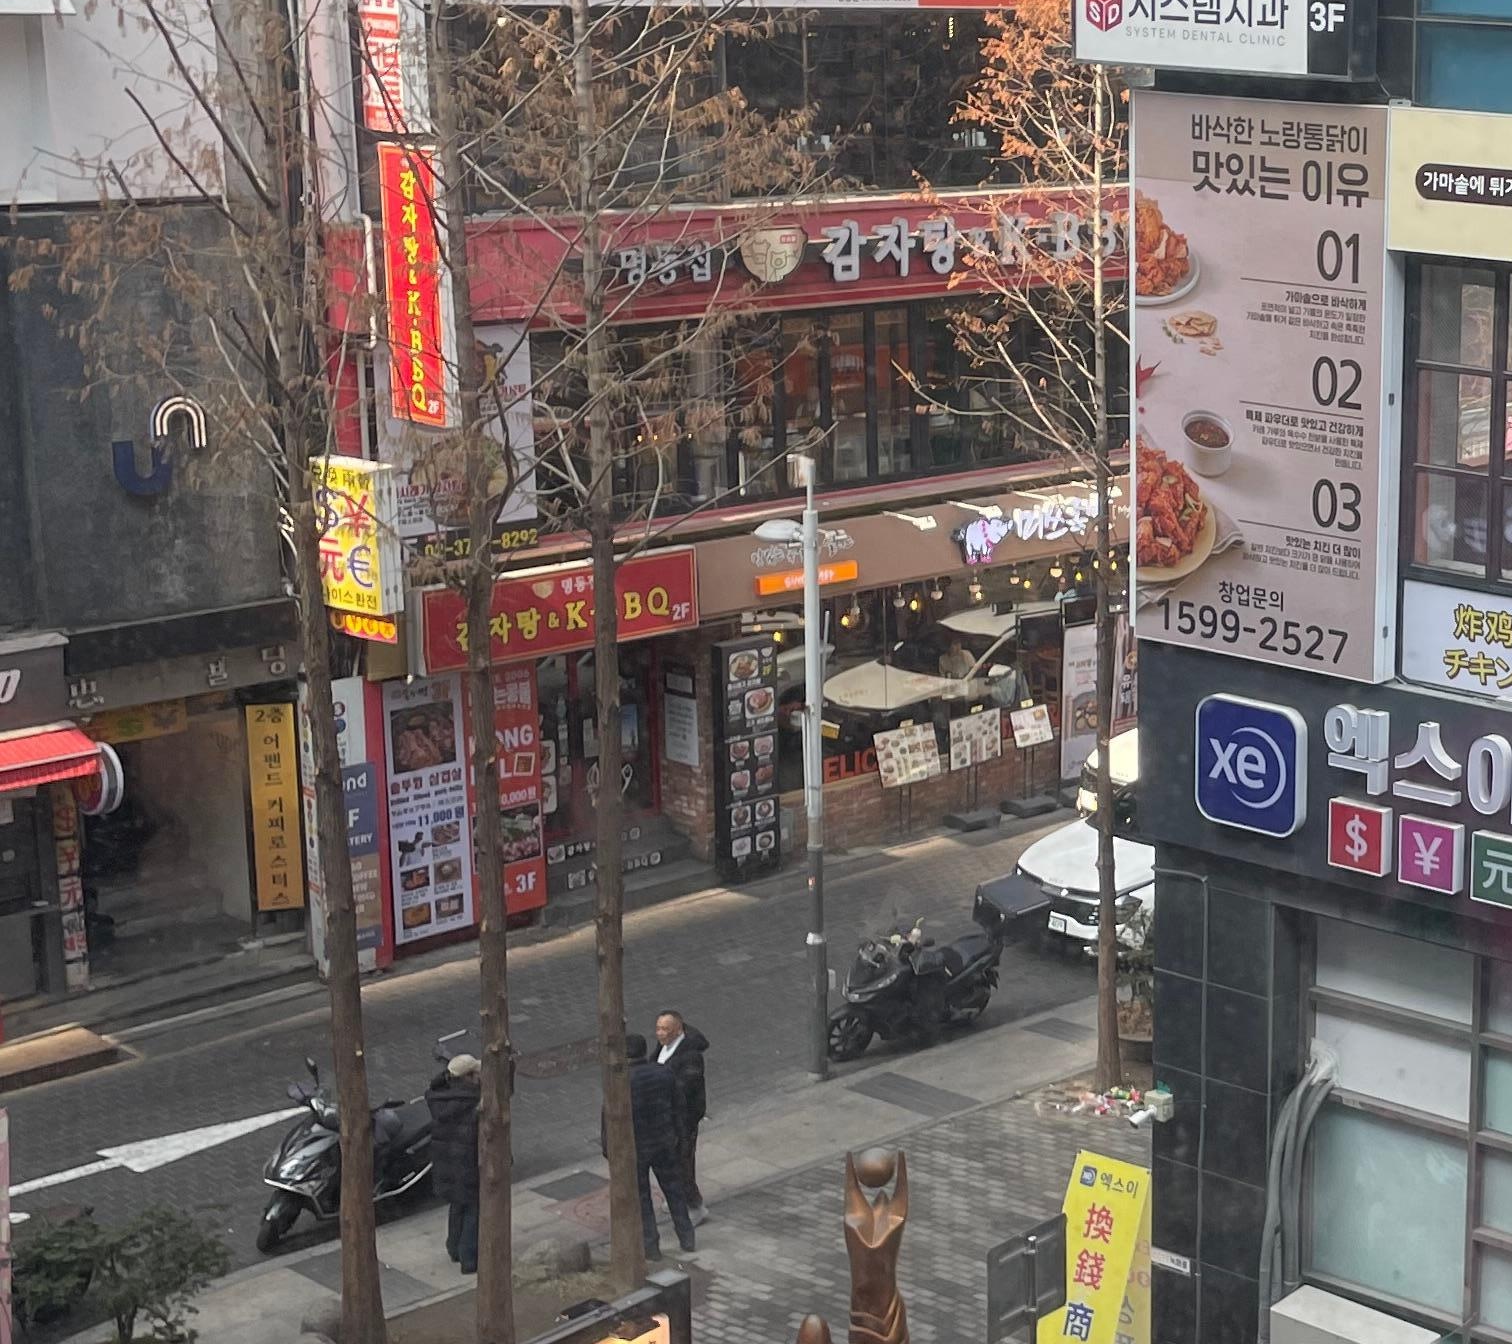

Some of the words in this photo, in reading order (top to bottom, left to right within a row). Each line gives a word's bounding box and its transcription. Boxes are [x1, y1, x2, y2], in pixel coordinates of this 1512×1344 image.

[1126, 26, 1176, 40] SYSTEM
[1182, 29, 1233, 43] DENTAL
[1239, 31, 1286, 47] CLINIC
[1309, 1, 1346, 32] 3F
[1191, 114, 1253, 145] 바삭한
[1260, 119, 1368, 155] 노랑통닭이
[1192, 151, 1290, 200] 맛있는
[1302, 160, 1369, 208] 이유
[1423, 171, 1484, 195] 가마솥에
[618, 241, 713, 286] 명동집
[822, 215, 959, 282] 감자탕
[1317, 230, 1359, 284] 01
[1311, 355, 1362, 410] 02
[1312, 478, 1361, 532] 03
[347, 544, 372, 588] €
[1314, 540, 1330, 553] 치킨
[1333, 544, 1340, 555] 더
[672, 601, 690, 622] 2F
[1218, 580, 1284, 612] 창업문의
[1158, 597, 1348, 664] 1599-2527
[1344, 814, 1368, 863] $
[516, 871, 536, 894] 3F
